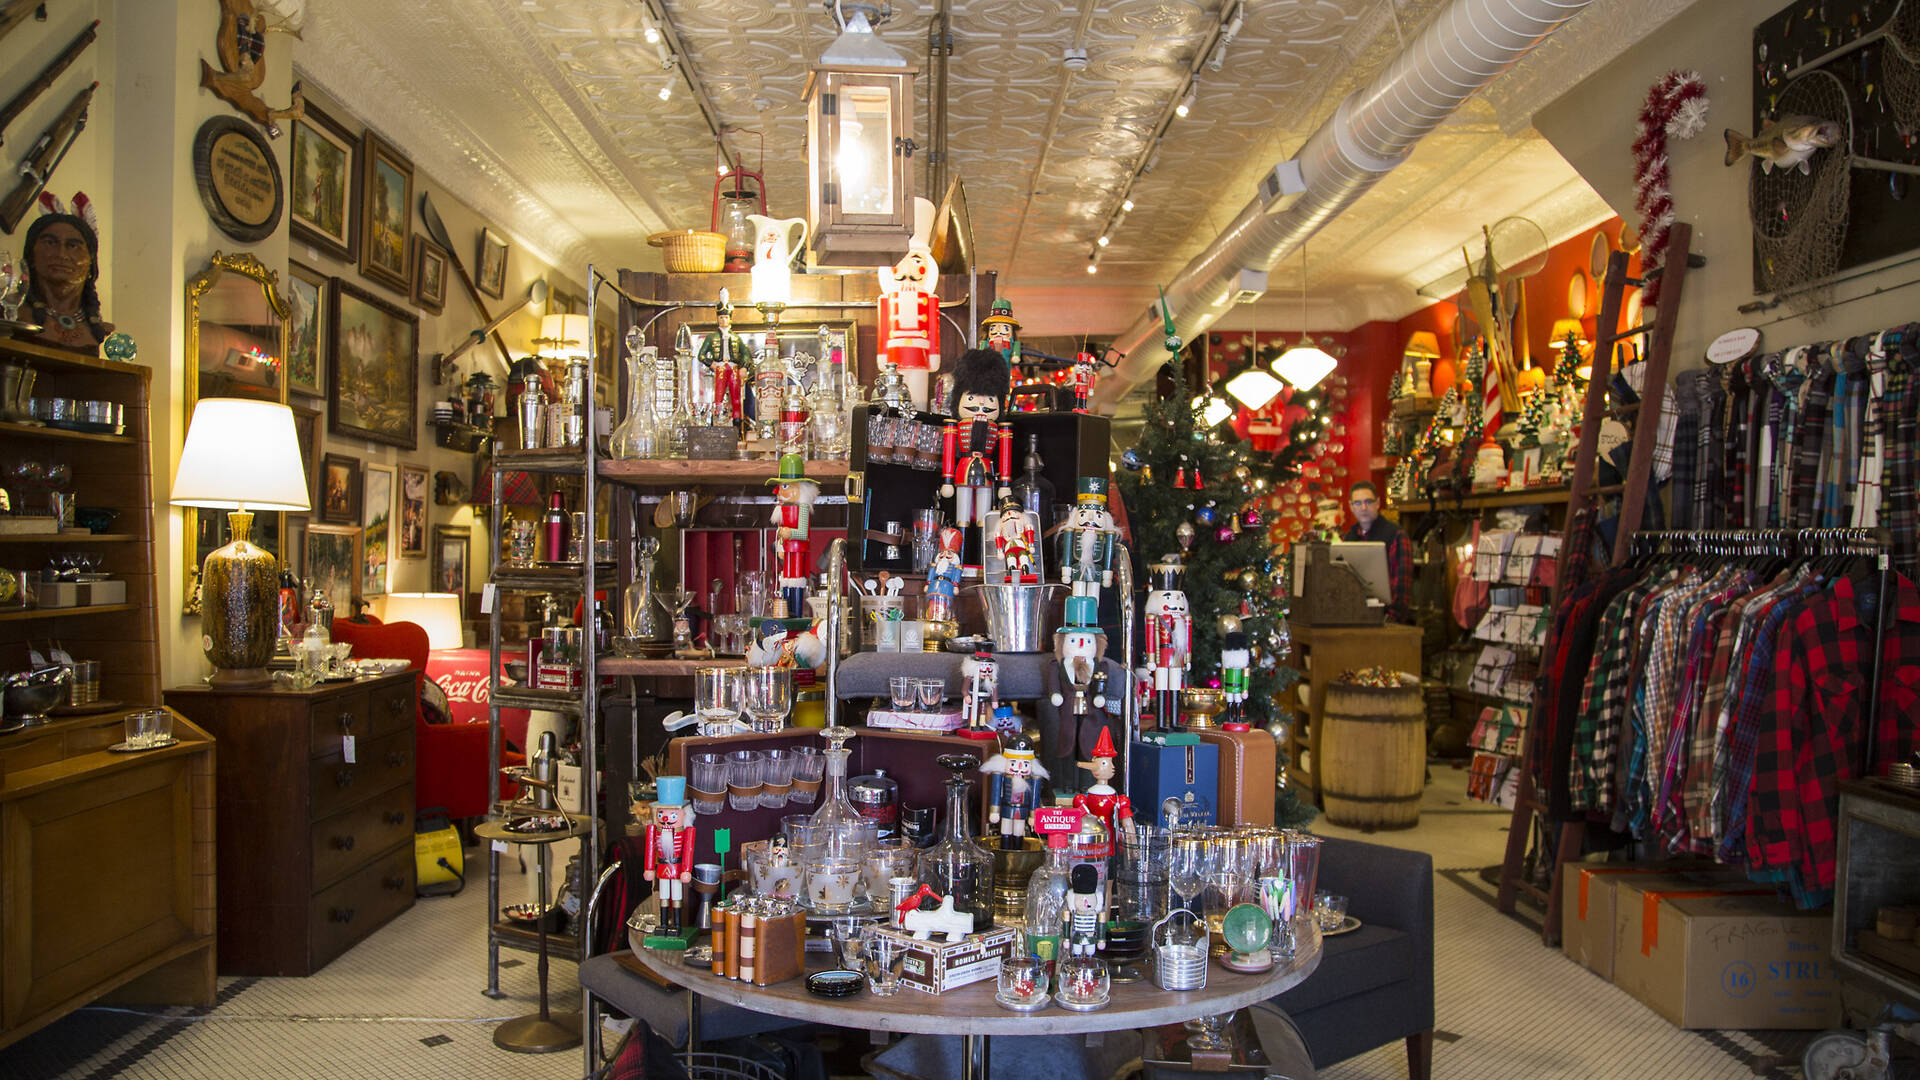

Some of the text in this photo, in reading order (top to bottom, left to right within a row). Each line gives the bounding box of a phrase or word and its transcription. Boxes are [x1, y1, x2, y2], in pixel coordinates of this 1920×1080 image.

[435, 674, 491, 704] Coca-C
[1040, 815, 1076, 824] ANTIQUE
[955, 956, 976, 967] ROMEO
[1730, 971, 1751, 988] 16
